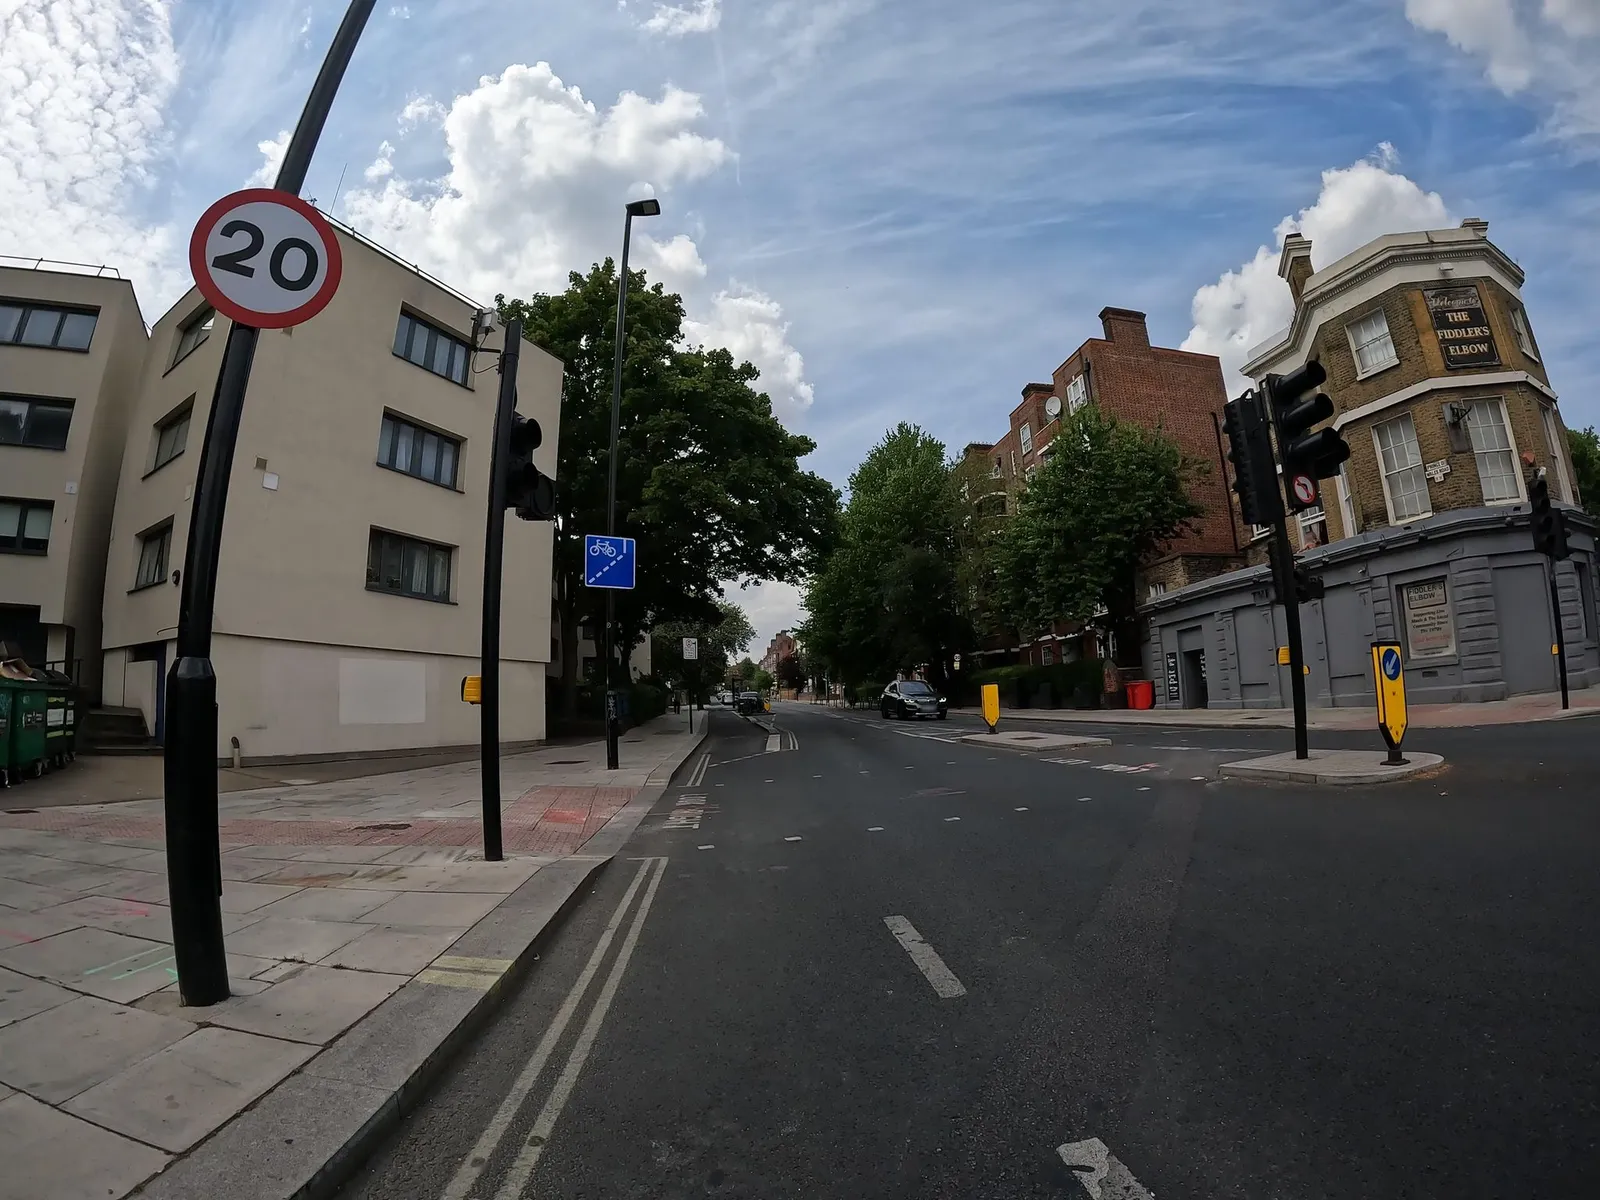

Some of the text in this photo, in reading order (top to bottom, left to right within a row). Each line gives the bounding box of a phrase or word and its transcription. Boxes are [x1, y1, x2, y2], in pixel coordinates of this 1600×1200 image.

[212, 219, 318, 291] 20
[1446, 311, 1470, 322] THE
[1437, 326, 1490, 339] FIDDLER'S
[1448, 343, 1488, 355] ELBOW
[1409, 592, 1436, 602] ELBOW
